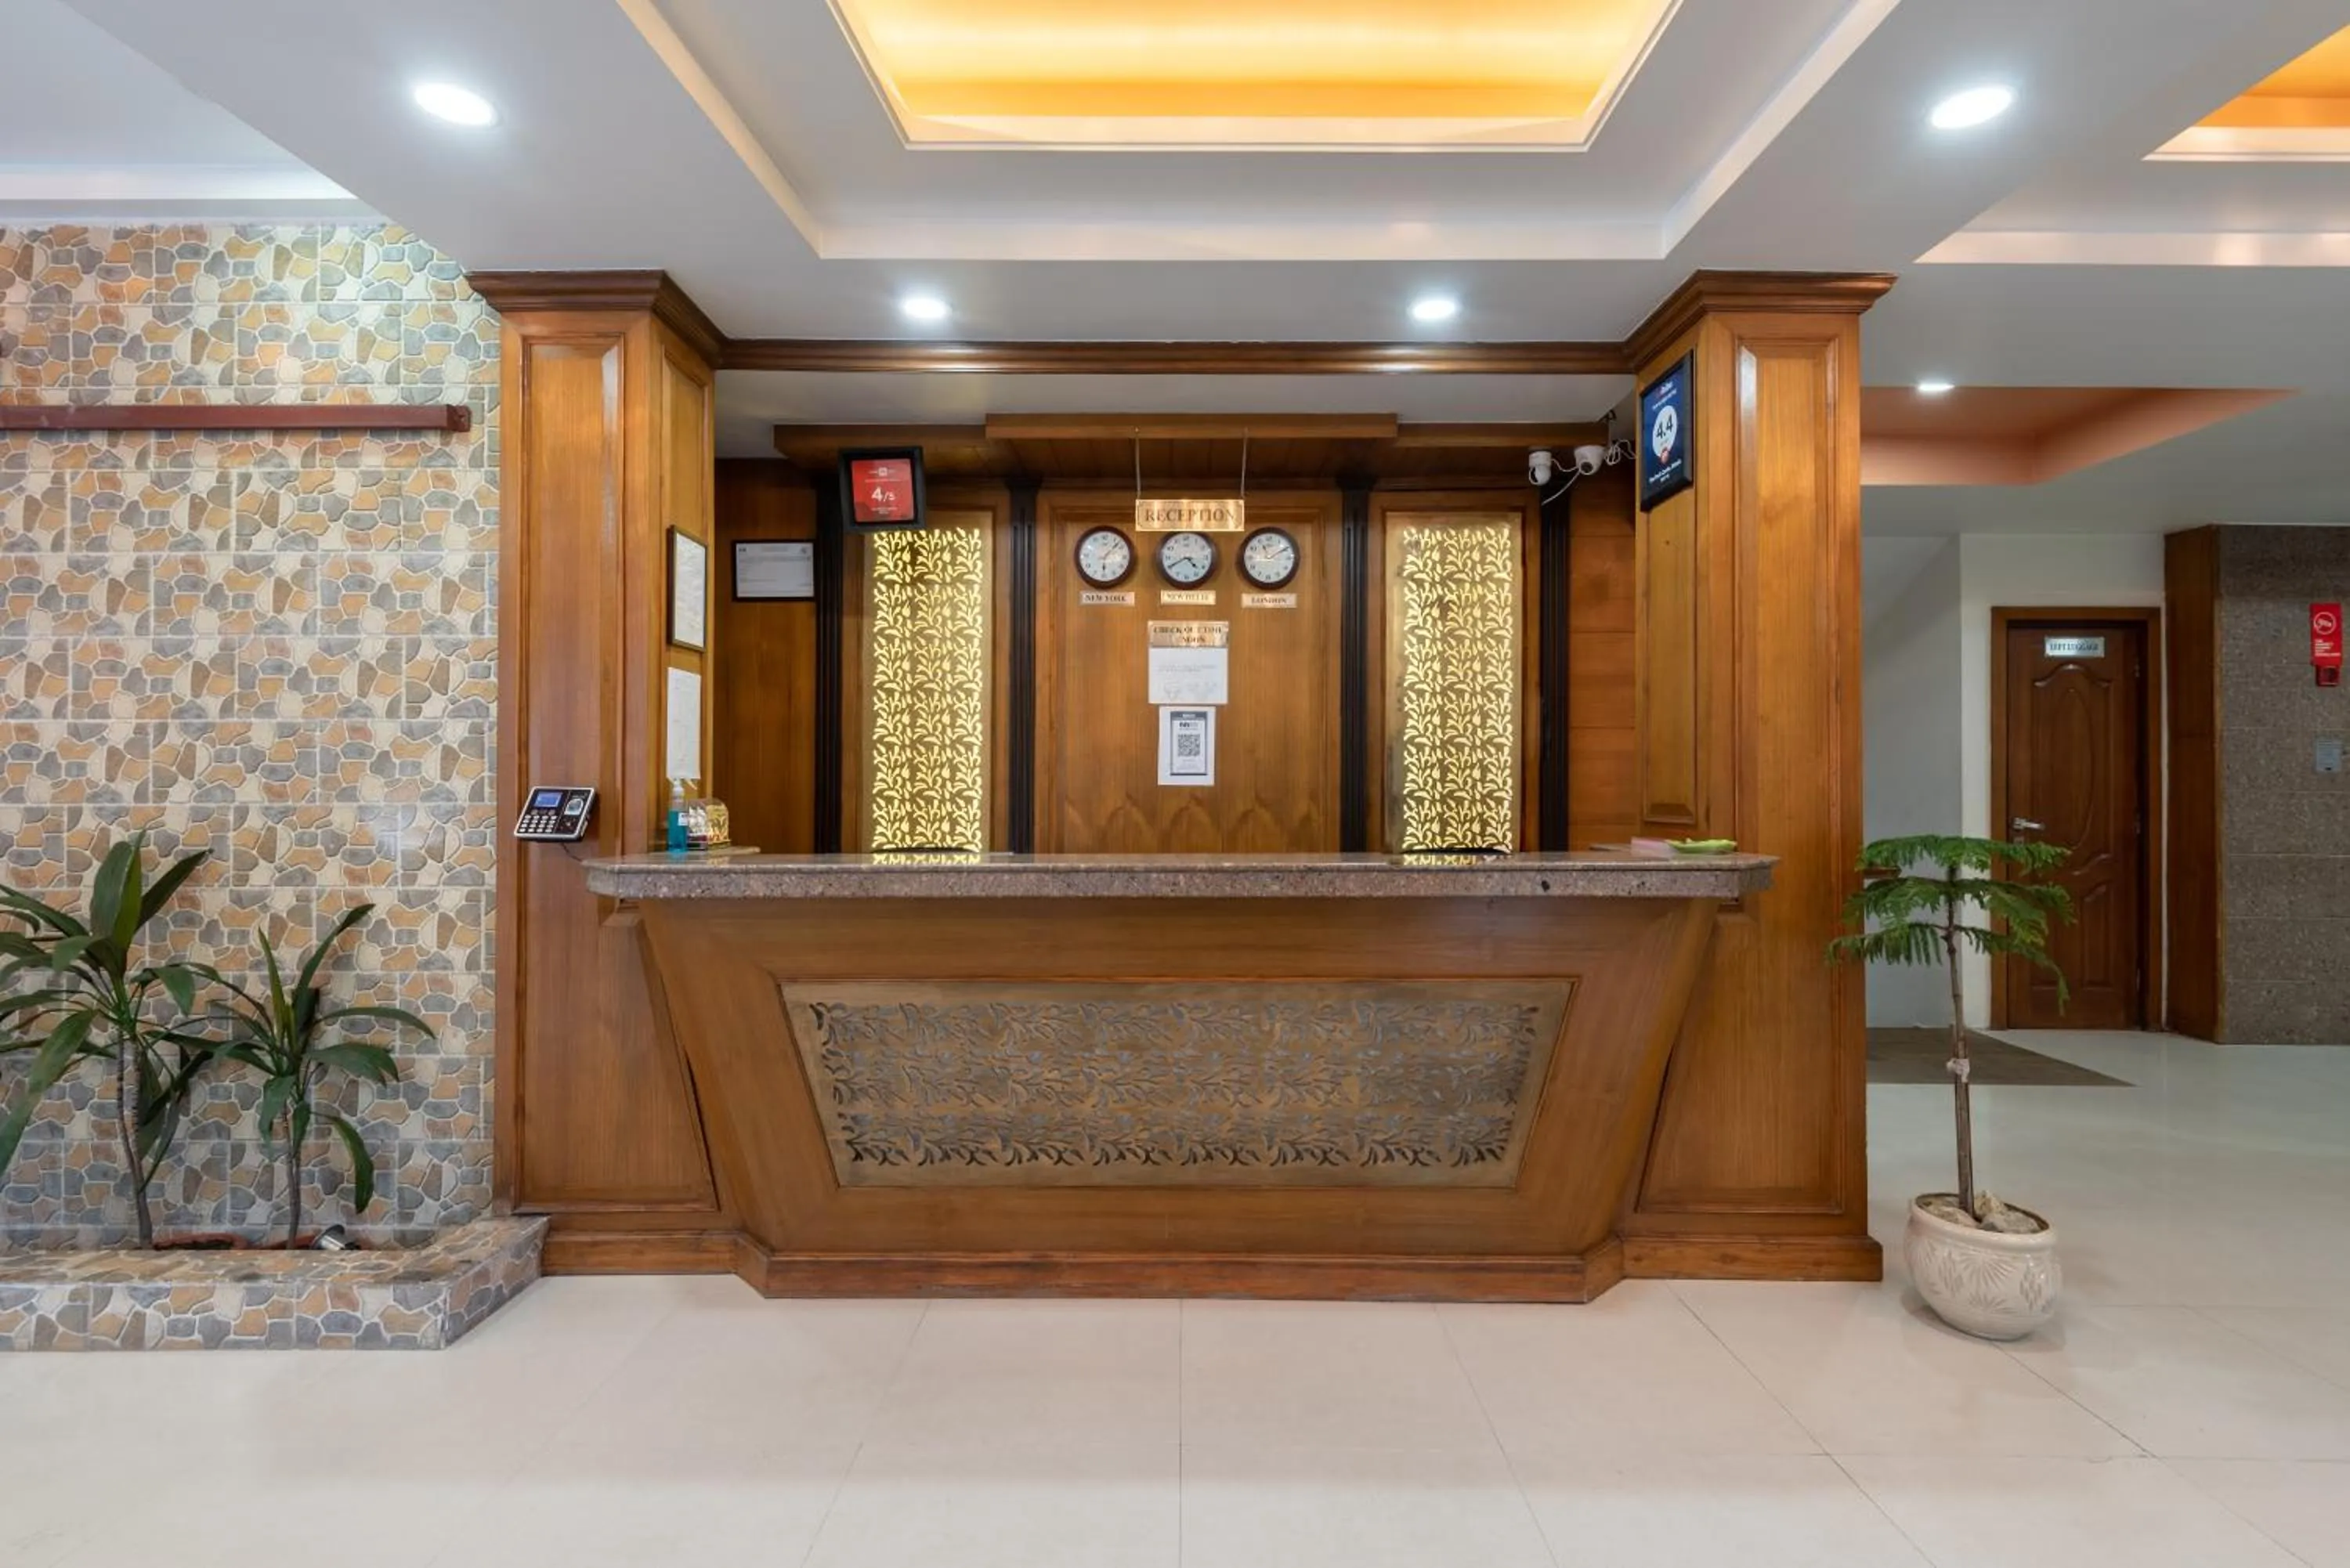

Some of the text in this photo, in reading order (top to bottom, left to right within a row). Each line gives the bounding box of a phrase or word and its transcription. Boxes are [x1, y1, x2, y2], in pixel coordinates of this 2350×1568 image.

[1656, 413, 1674, 439] 4.4
[871, 486, 895, 502] 4/5
[1145, 508, 1236, 522] RECEPTION
